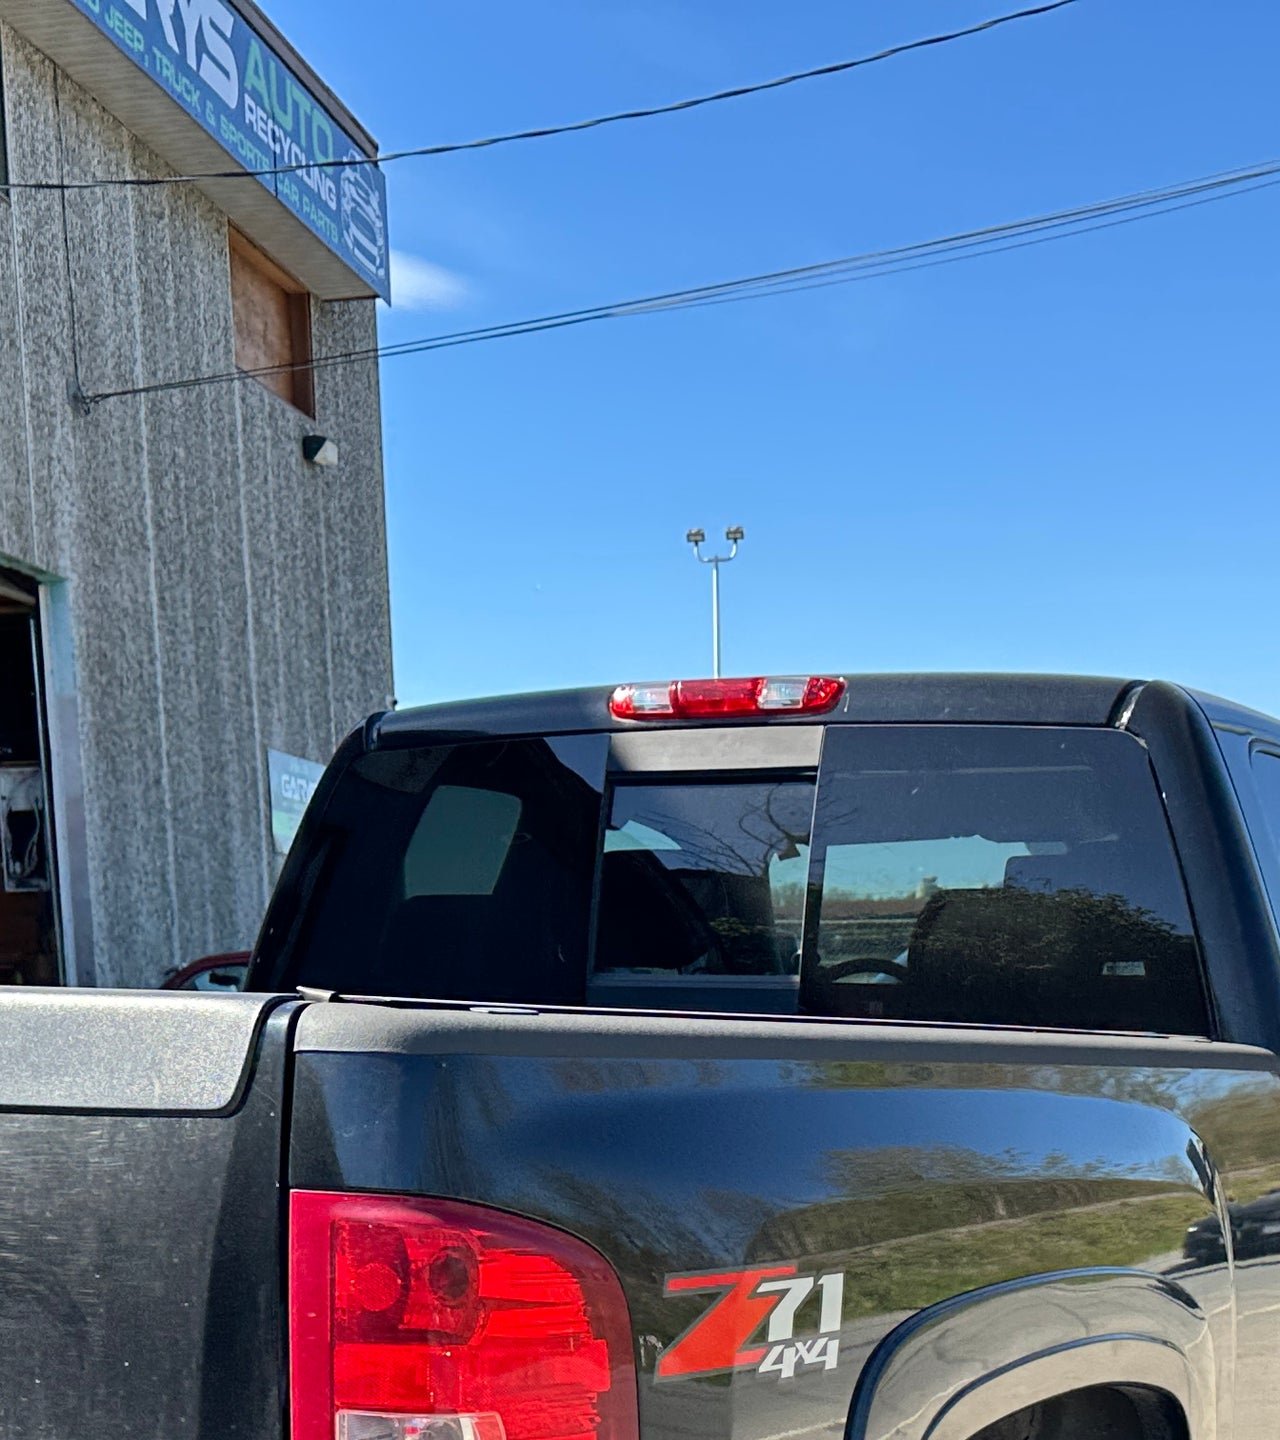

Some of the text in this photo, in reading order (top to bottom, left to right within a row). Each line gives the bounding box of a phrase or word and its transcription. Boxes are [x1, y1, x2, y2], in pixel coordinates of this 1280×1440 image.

[152, 46, 201, 112] TRUCK
[220, 114, 271, 180] SPORTS
[303, 193, 339, 244] PARTS
[244, 39, 334, 176] AUTO
[244, 93, 337, 211] RECYCLING
[658, 1264, 844, 1377] Z71
